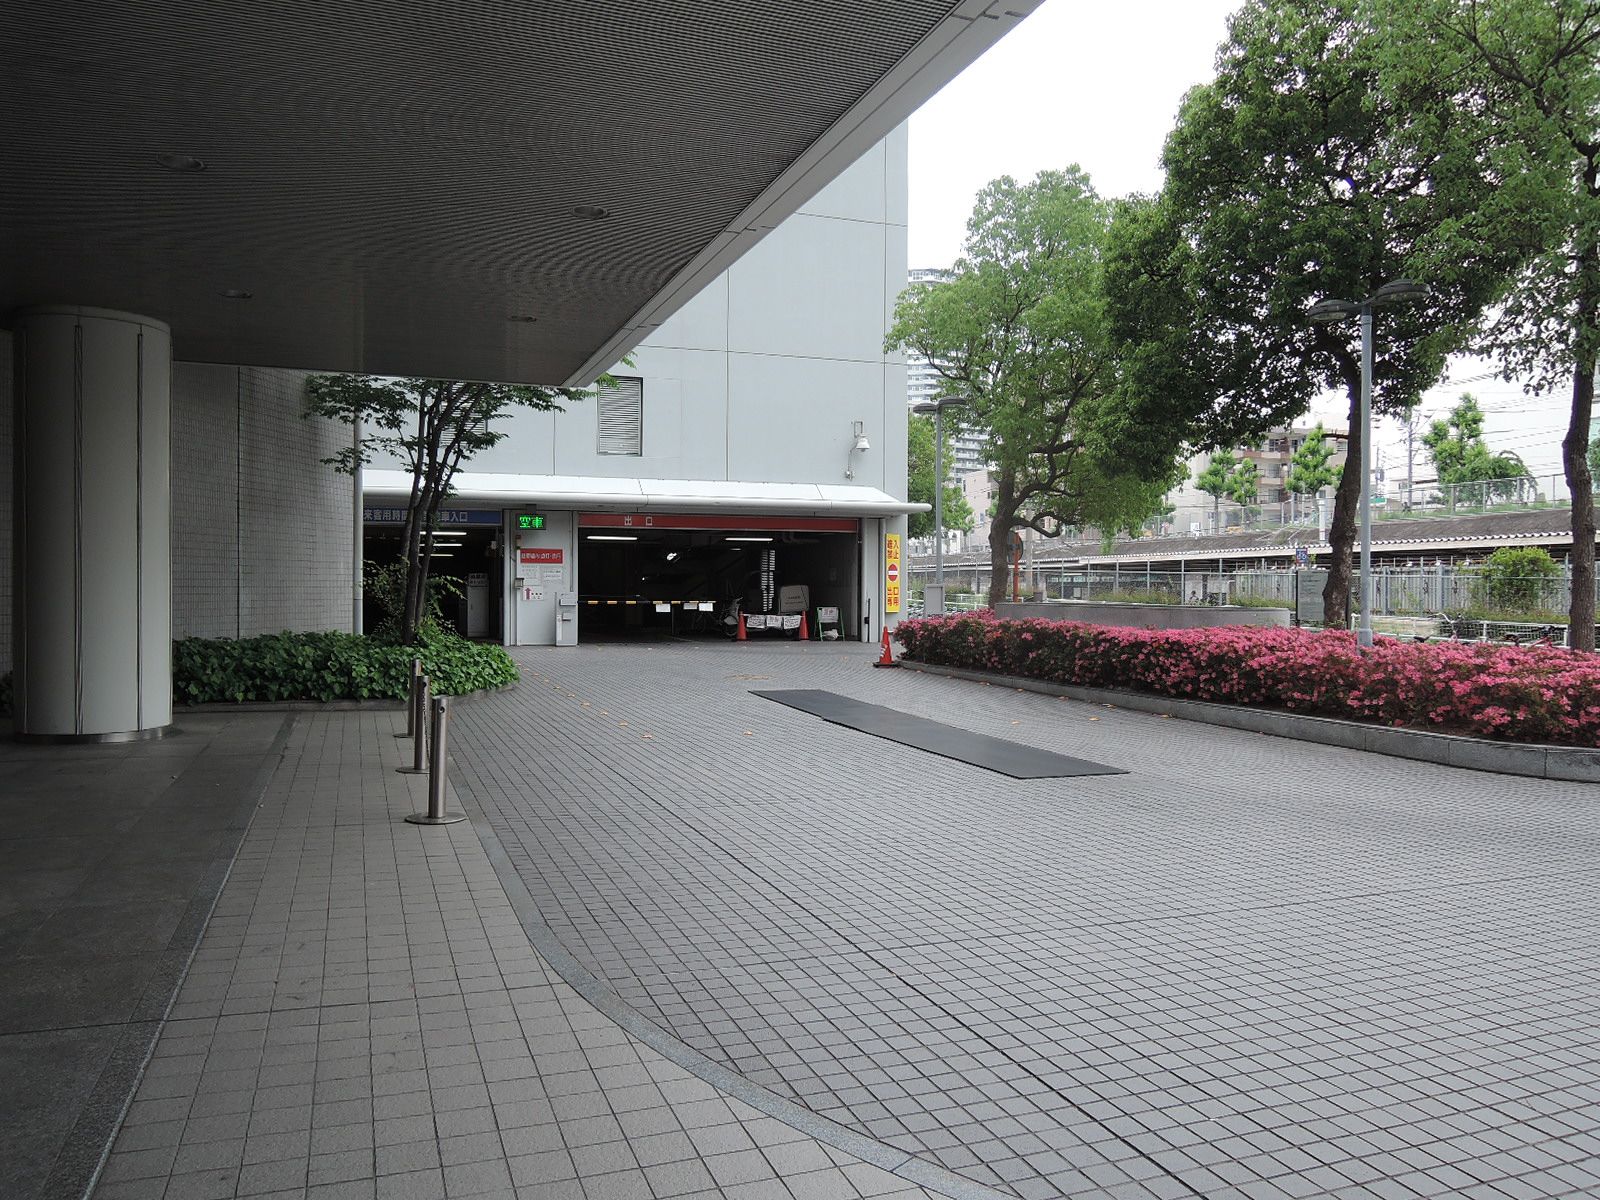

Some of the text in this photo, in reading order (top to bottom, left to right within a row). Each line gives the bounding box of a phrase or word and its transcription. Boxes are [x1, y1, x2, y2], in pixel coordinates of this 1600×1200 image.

[519, 516, 544, 528] 空車
[624, 515, 653, 526] 出口
[887, 586, 899, 596] 出口
